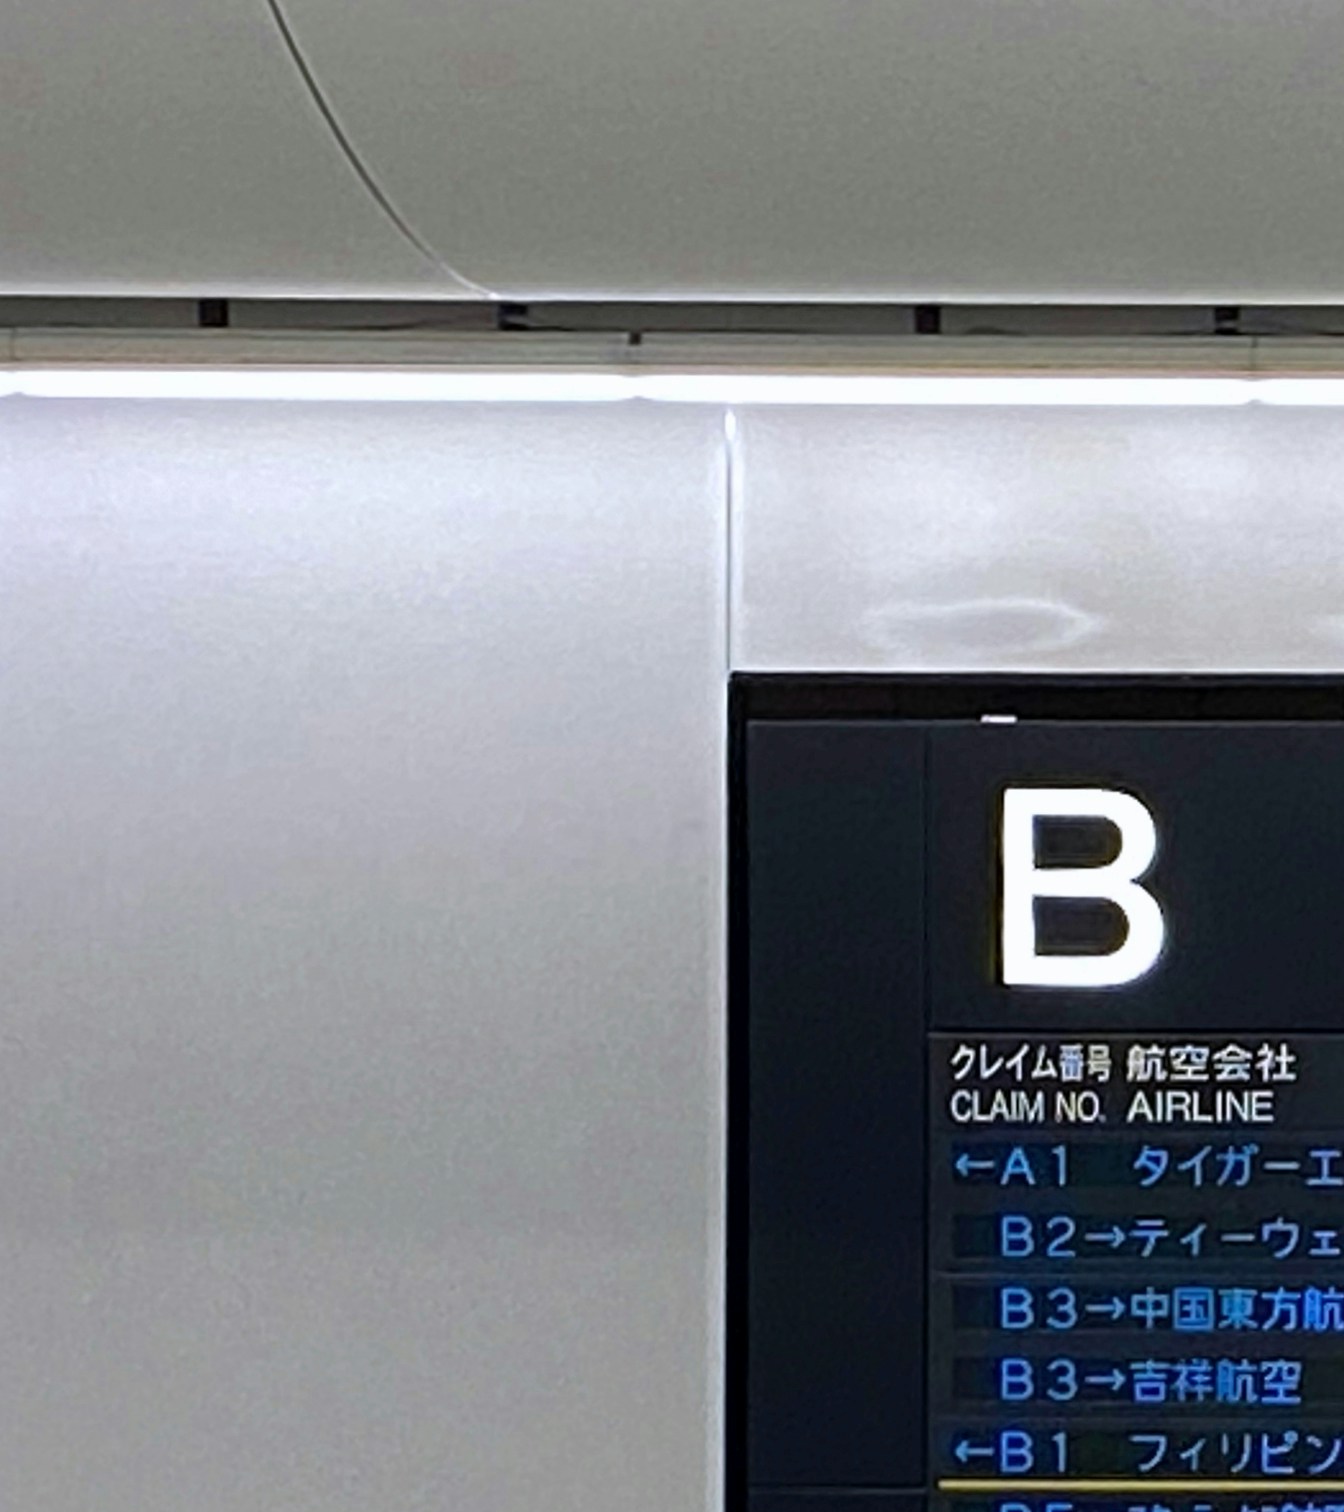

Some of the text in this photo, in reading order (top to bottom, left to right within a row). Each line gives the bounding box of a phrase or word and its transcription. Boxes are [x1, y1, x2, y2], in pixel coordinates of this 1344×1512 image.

[1001, 787, 1167, 990] B
[950, 1042, 1297, 1083] クレイム番号 航空会社
[949, 1088, 1275, 1124] CLAIM NO. AIRLINE
[999, 1144, 1067, 1187] A1
[1000, 1214, 1077, 1258] B2
[1000, 1286, 1078, 1330] B3
[1000, 1357, 1079, 1402] B3
[1129, 1357, 1303, 1406] 吉祥航空
[999, 1430, 1068, 1475] B1
